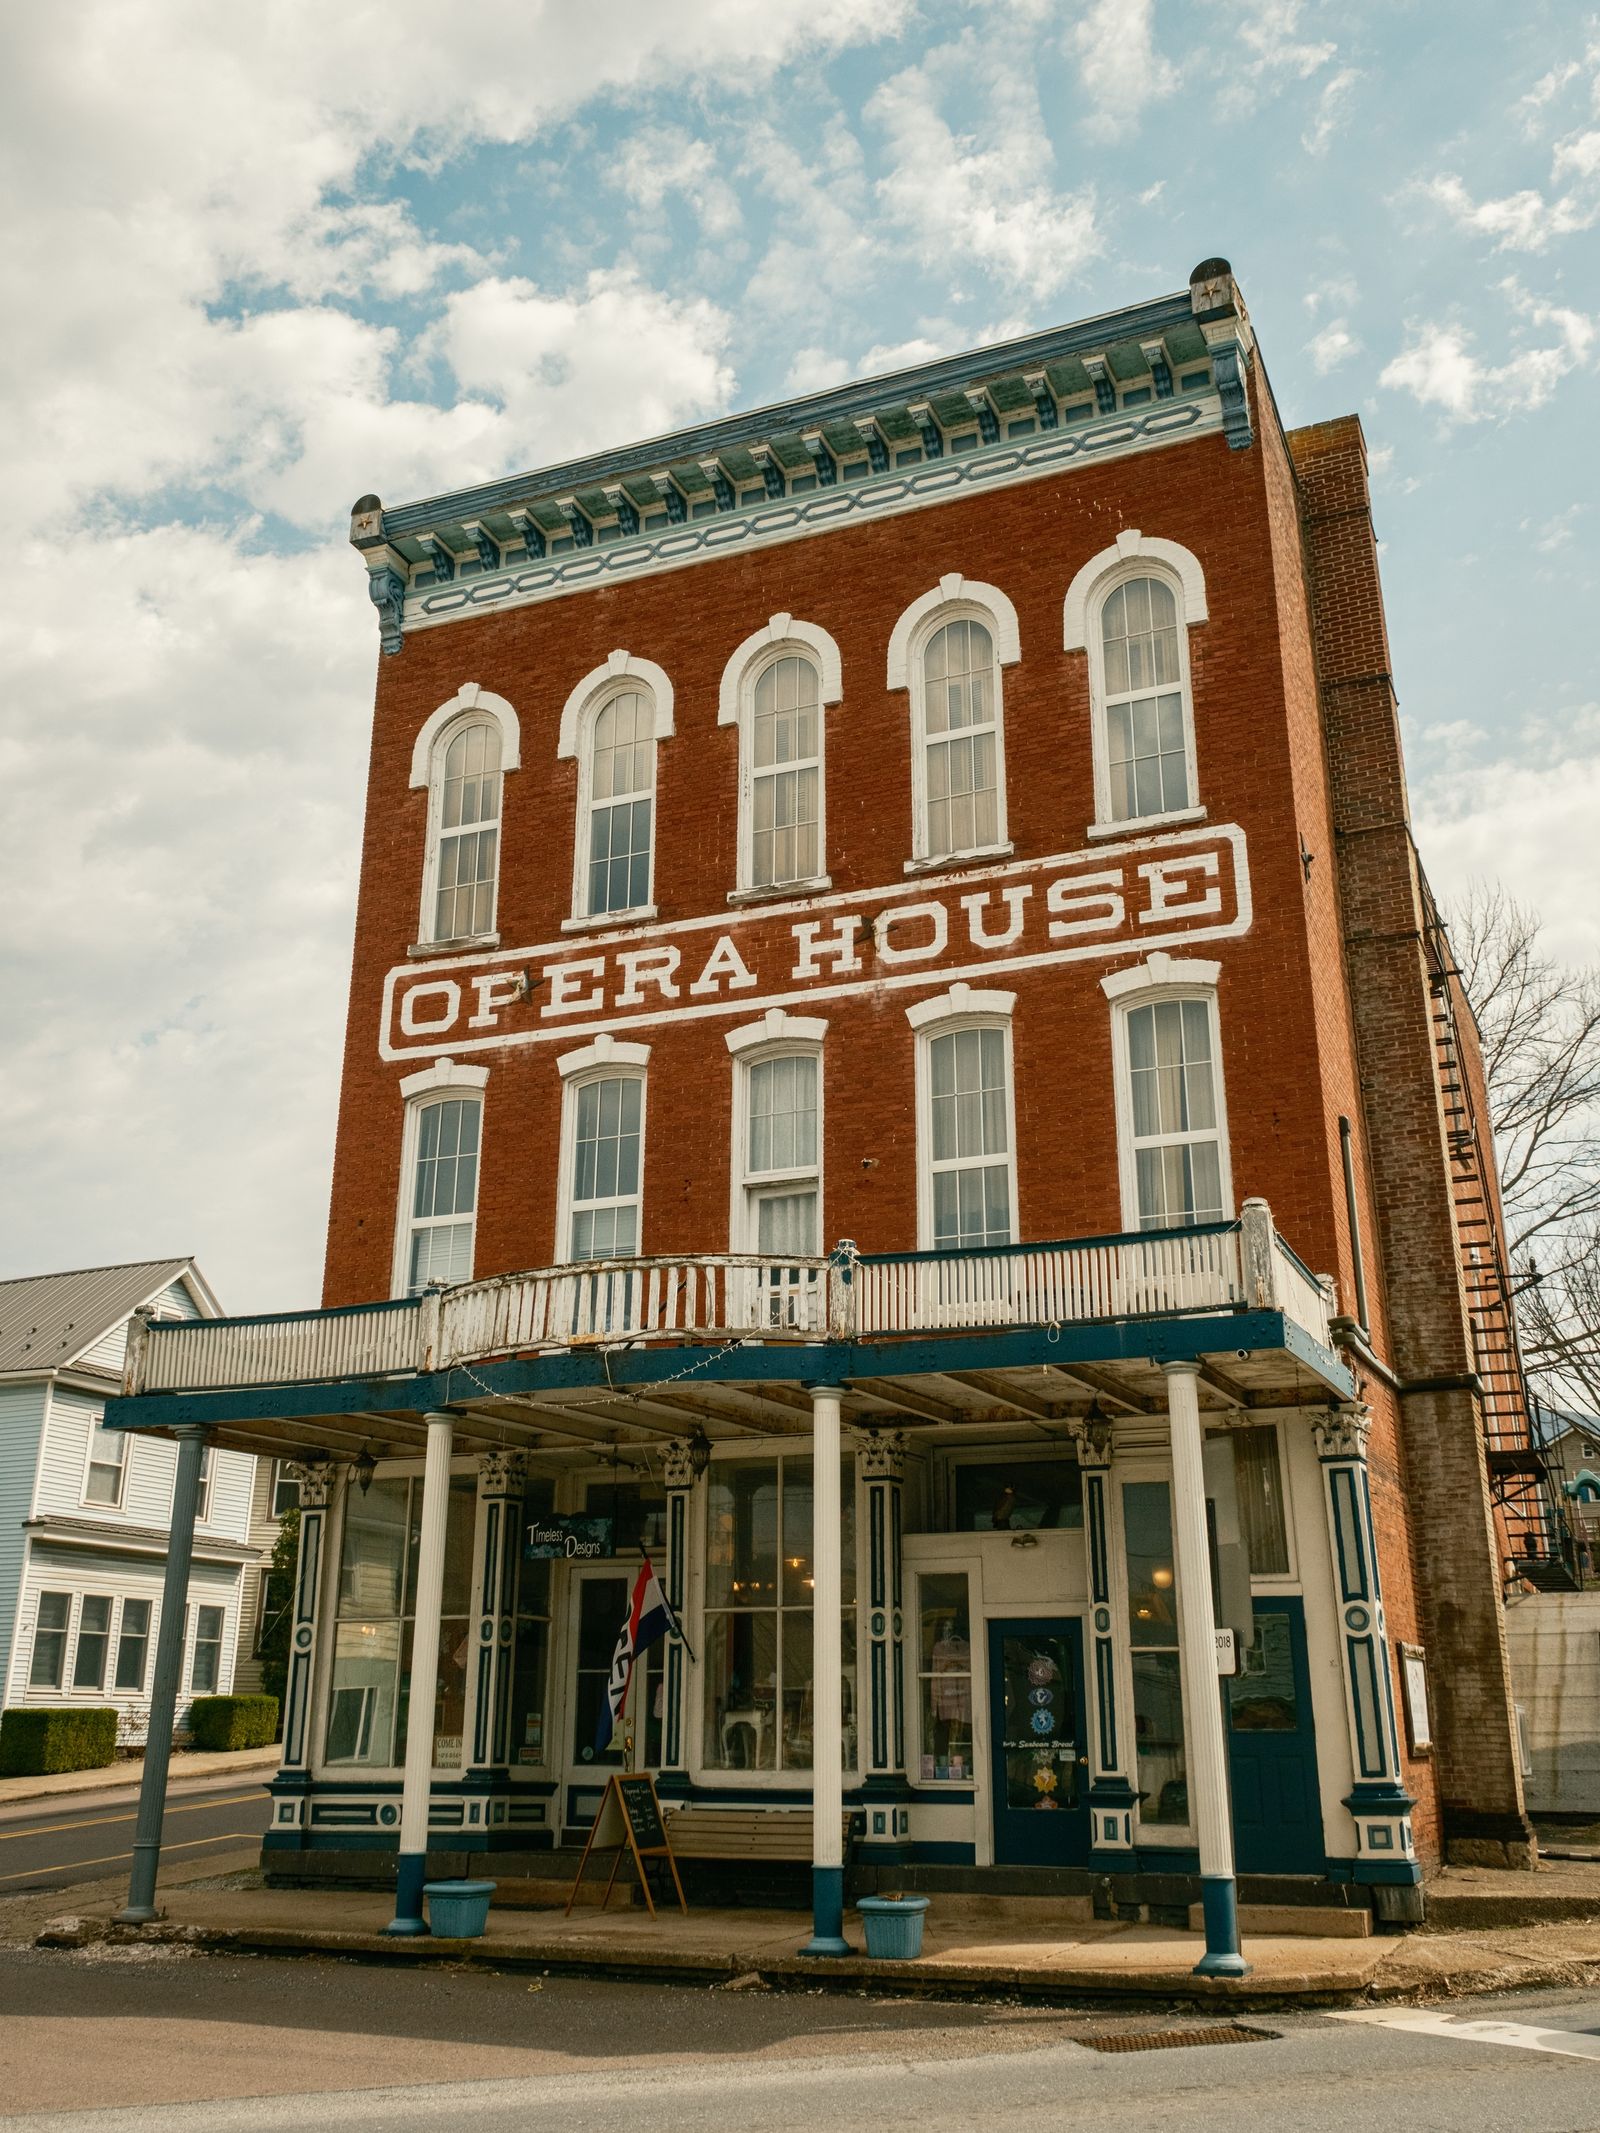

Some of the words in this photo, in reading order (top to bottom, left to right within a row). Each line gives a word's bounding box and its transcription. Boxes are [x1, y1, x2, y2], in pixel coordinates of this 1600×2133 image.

[400, 936, 757, 1036] OPERA
[791, 852, 1222, 979] HOUSE
[527, 1521, 563, 1545] Timeless
[564, 1535, 600, 1558] Designs
[437, 1738, 455, 1748] COME
[1051, 1740, 1074, 1748] Bread
